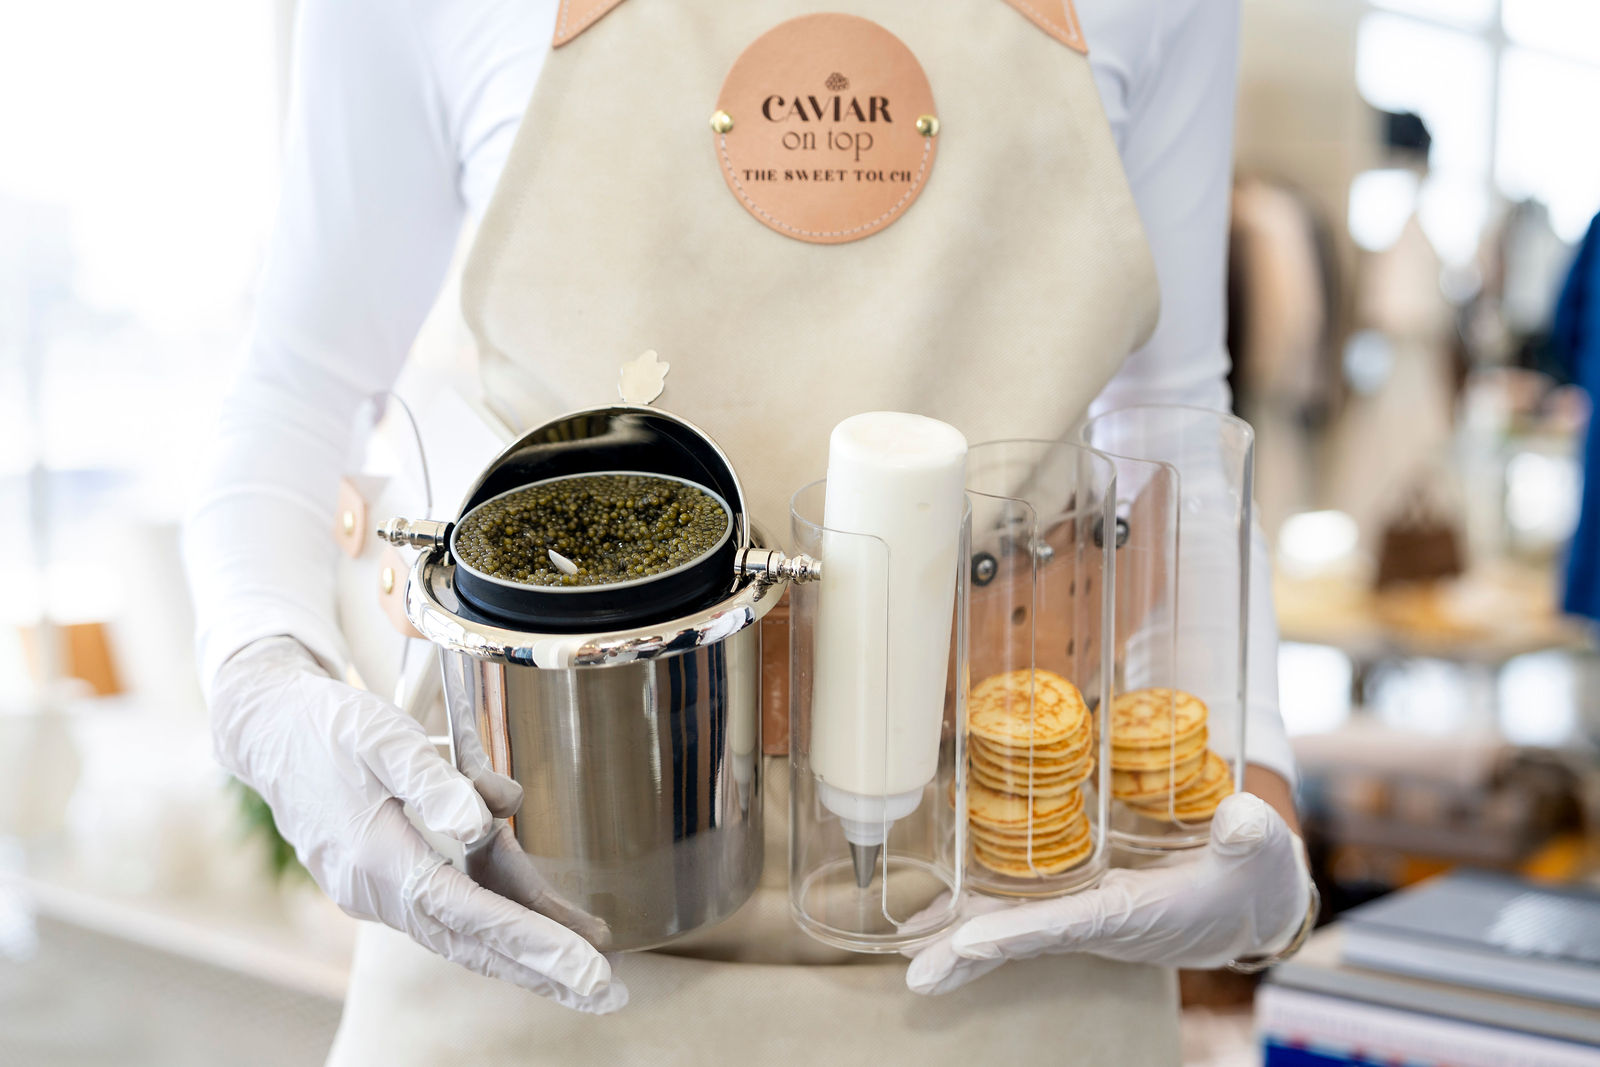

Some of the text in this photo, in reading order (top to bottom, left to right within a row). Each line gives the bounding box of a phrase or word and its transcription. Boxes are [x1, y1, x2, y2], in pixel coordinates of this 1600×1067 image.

[761, 95, 893, 123] CAVIAR
[782, 130, 874, 162] on top
[742, 169, 912, 182] THE SWEET TOUCH
